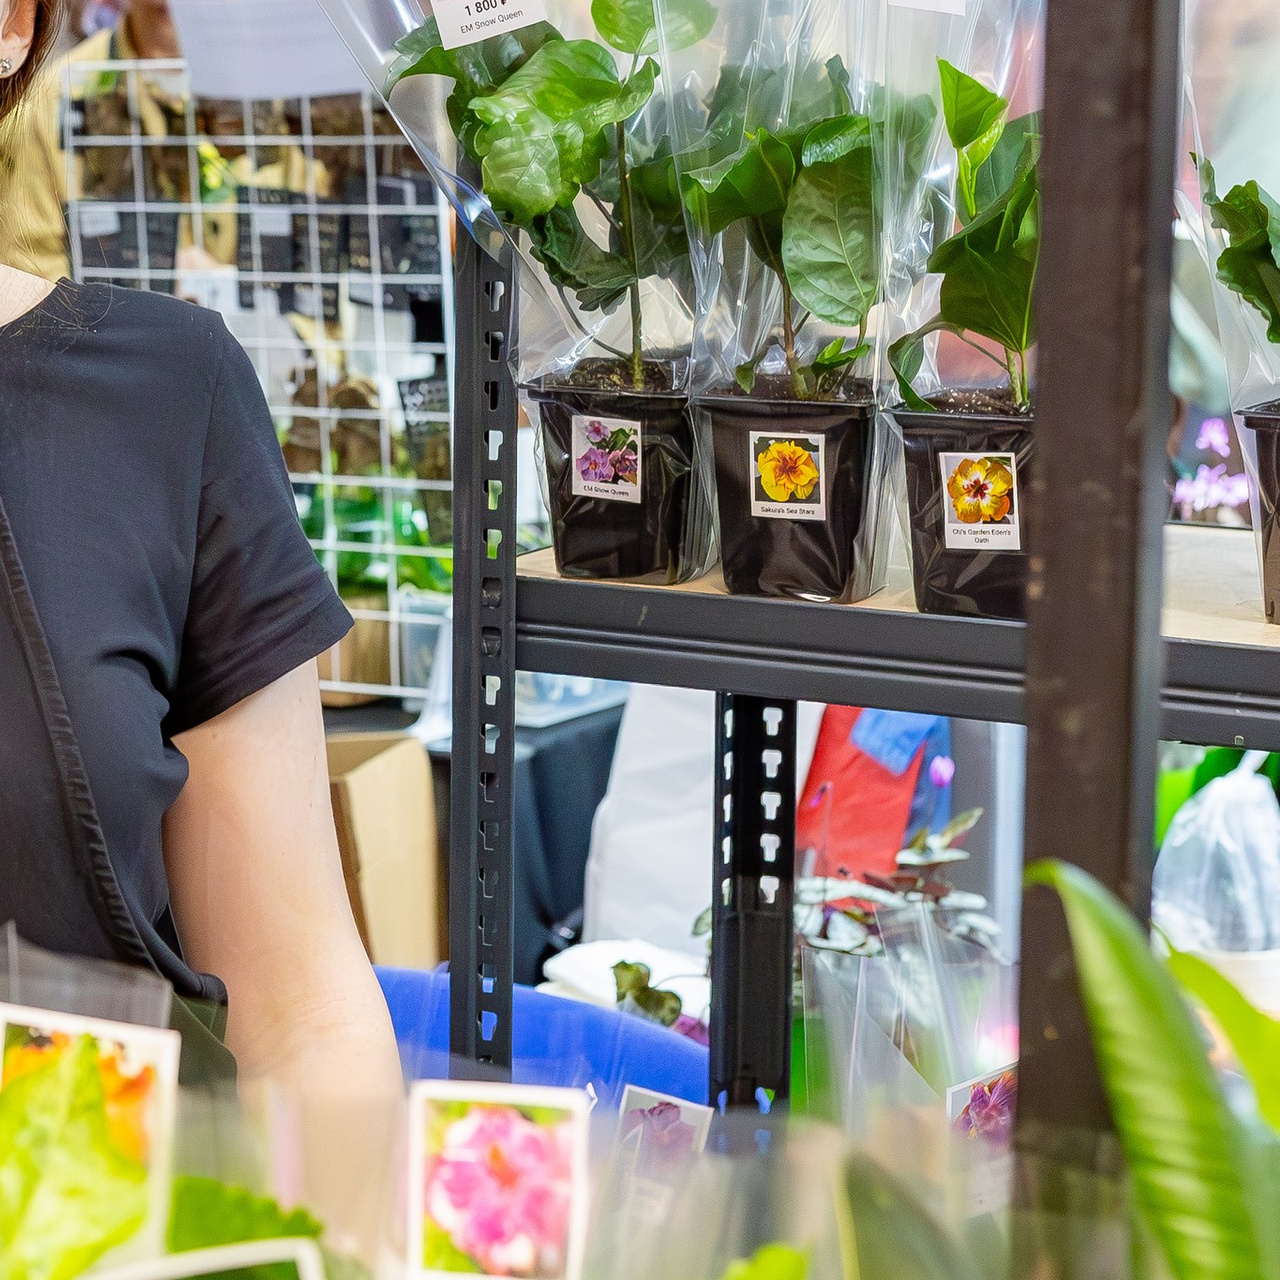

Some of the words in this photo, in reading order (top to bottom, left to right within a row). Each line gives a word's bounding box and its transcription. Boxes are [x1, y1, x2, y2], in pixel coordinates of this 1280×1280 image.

[464, 4, 472, 17] 1
[460, 24, 474, 34] EM
[474, 17, 496, 30] Snow
[497, 9, 524, 23] Queen
[967, 528, 990, 536] Garden
